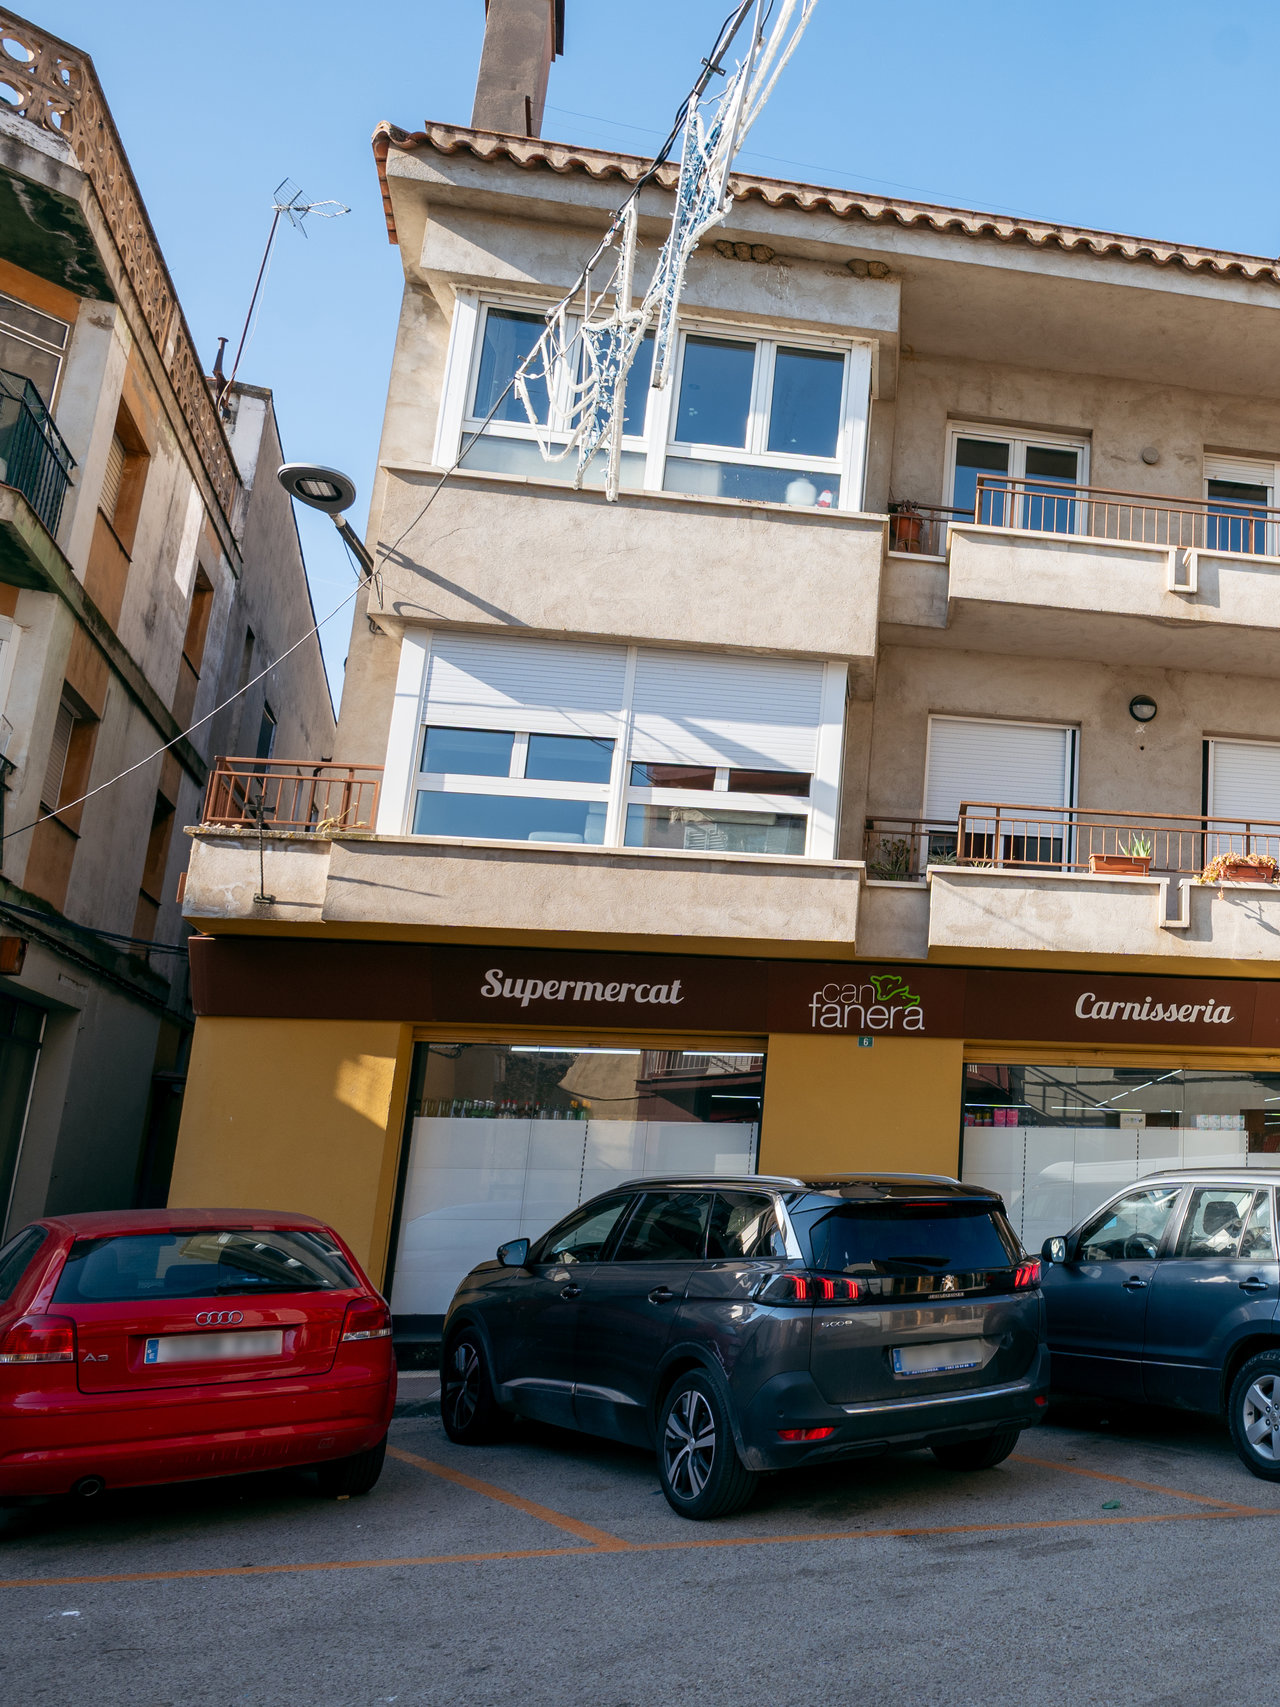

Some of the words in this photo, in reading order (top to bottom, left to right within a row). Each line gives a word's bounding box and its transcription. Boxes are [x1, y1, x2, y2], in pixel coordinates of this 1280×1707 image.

[480, 968, 684, 1007] Supermercat
[822, 983, 875, 1004] can
[808, 991, 925, 1031] fanera
[1075, 992, 1234, 1024] Carnisseria
[863, 1038, 869, 1046] 6
[82, 1353, 109, 1363] A3
